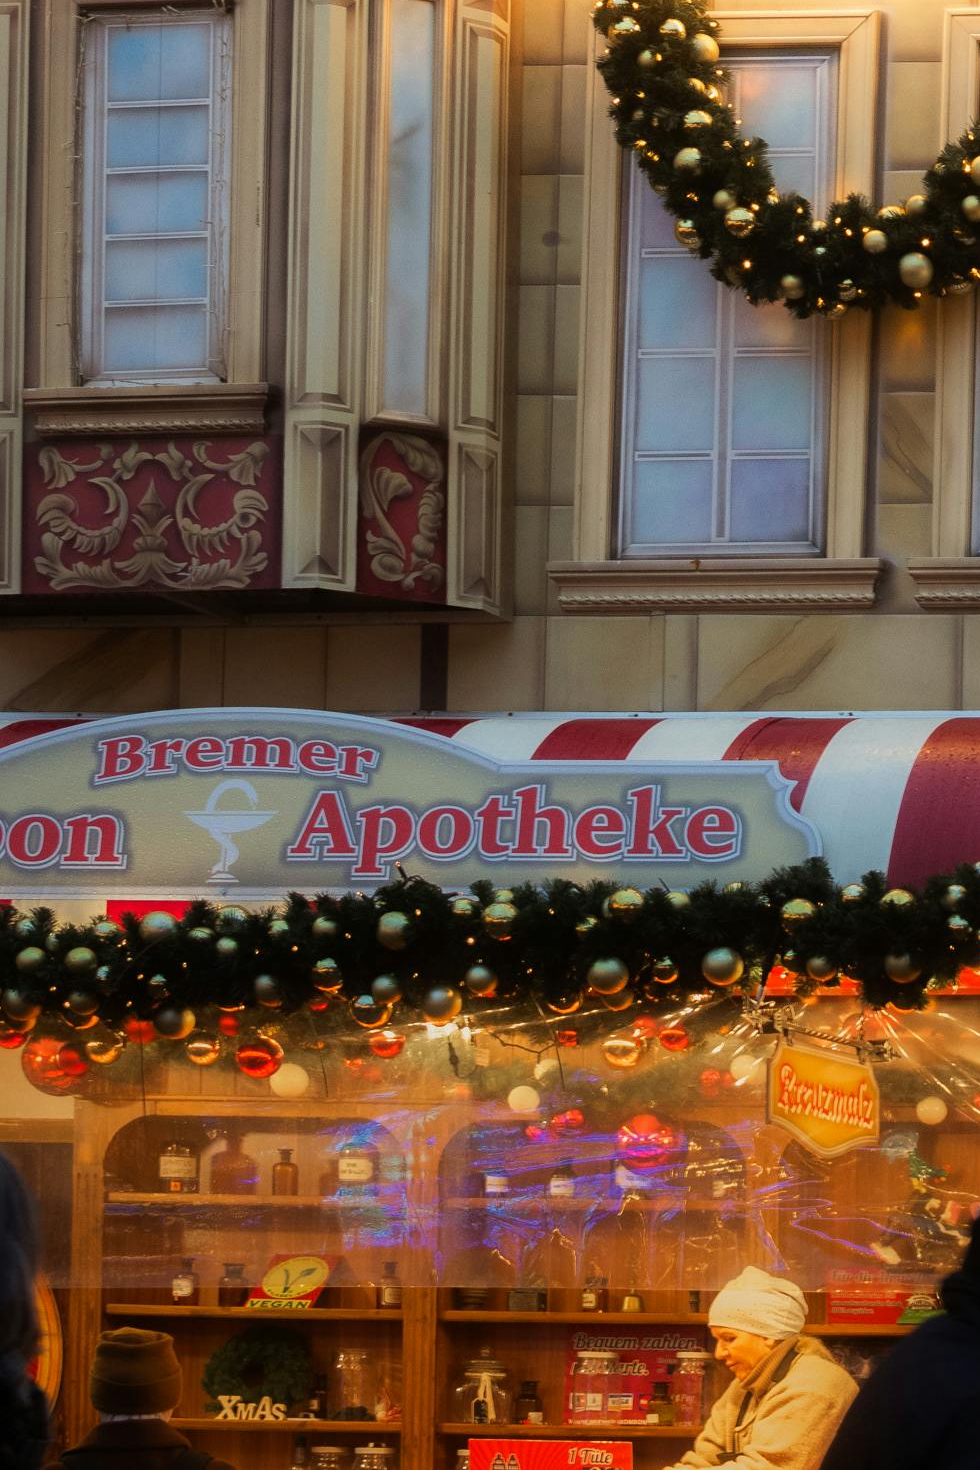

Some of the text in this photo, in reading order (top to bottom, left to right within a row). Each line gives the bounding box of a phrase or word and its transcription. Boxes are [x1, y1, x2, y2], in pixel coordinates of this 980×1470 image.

[94, 734, 381, 785] Bremer
[0, 783, 743, 880] on Apotheke
[249, 1299, 309, 1309] VEGAN
[575, 1333, 700, 1352] Bequem zahlen
[568, 1447, 578, 1465] 1
